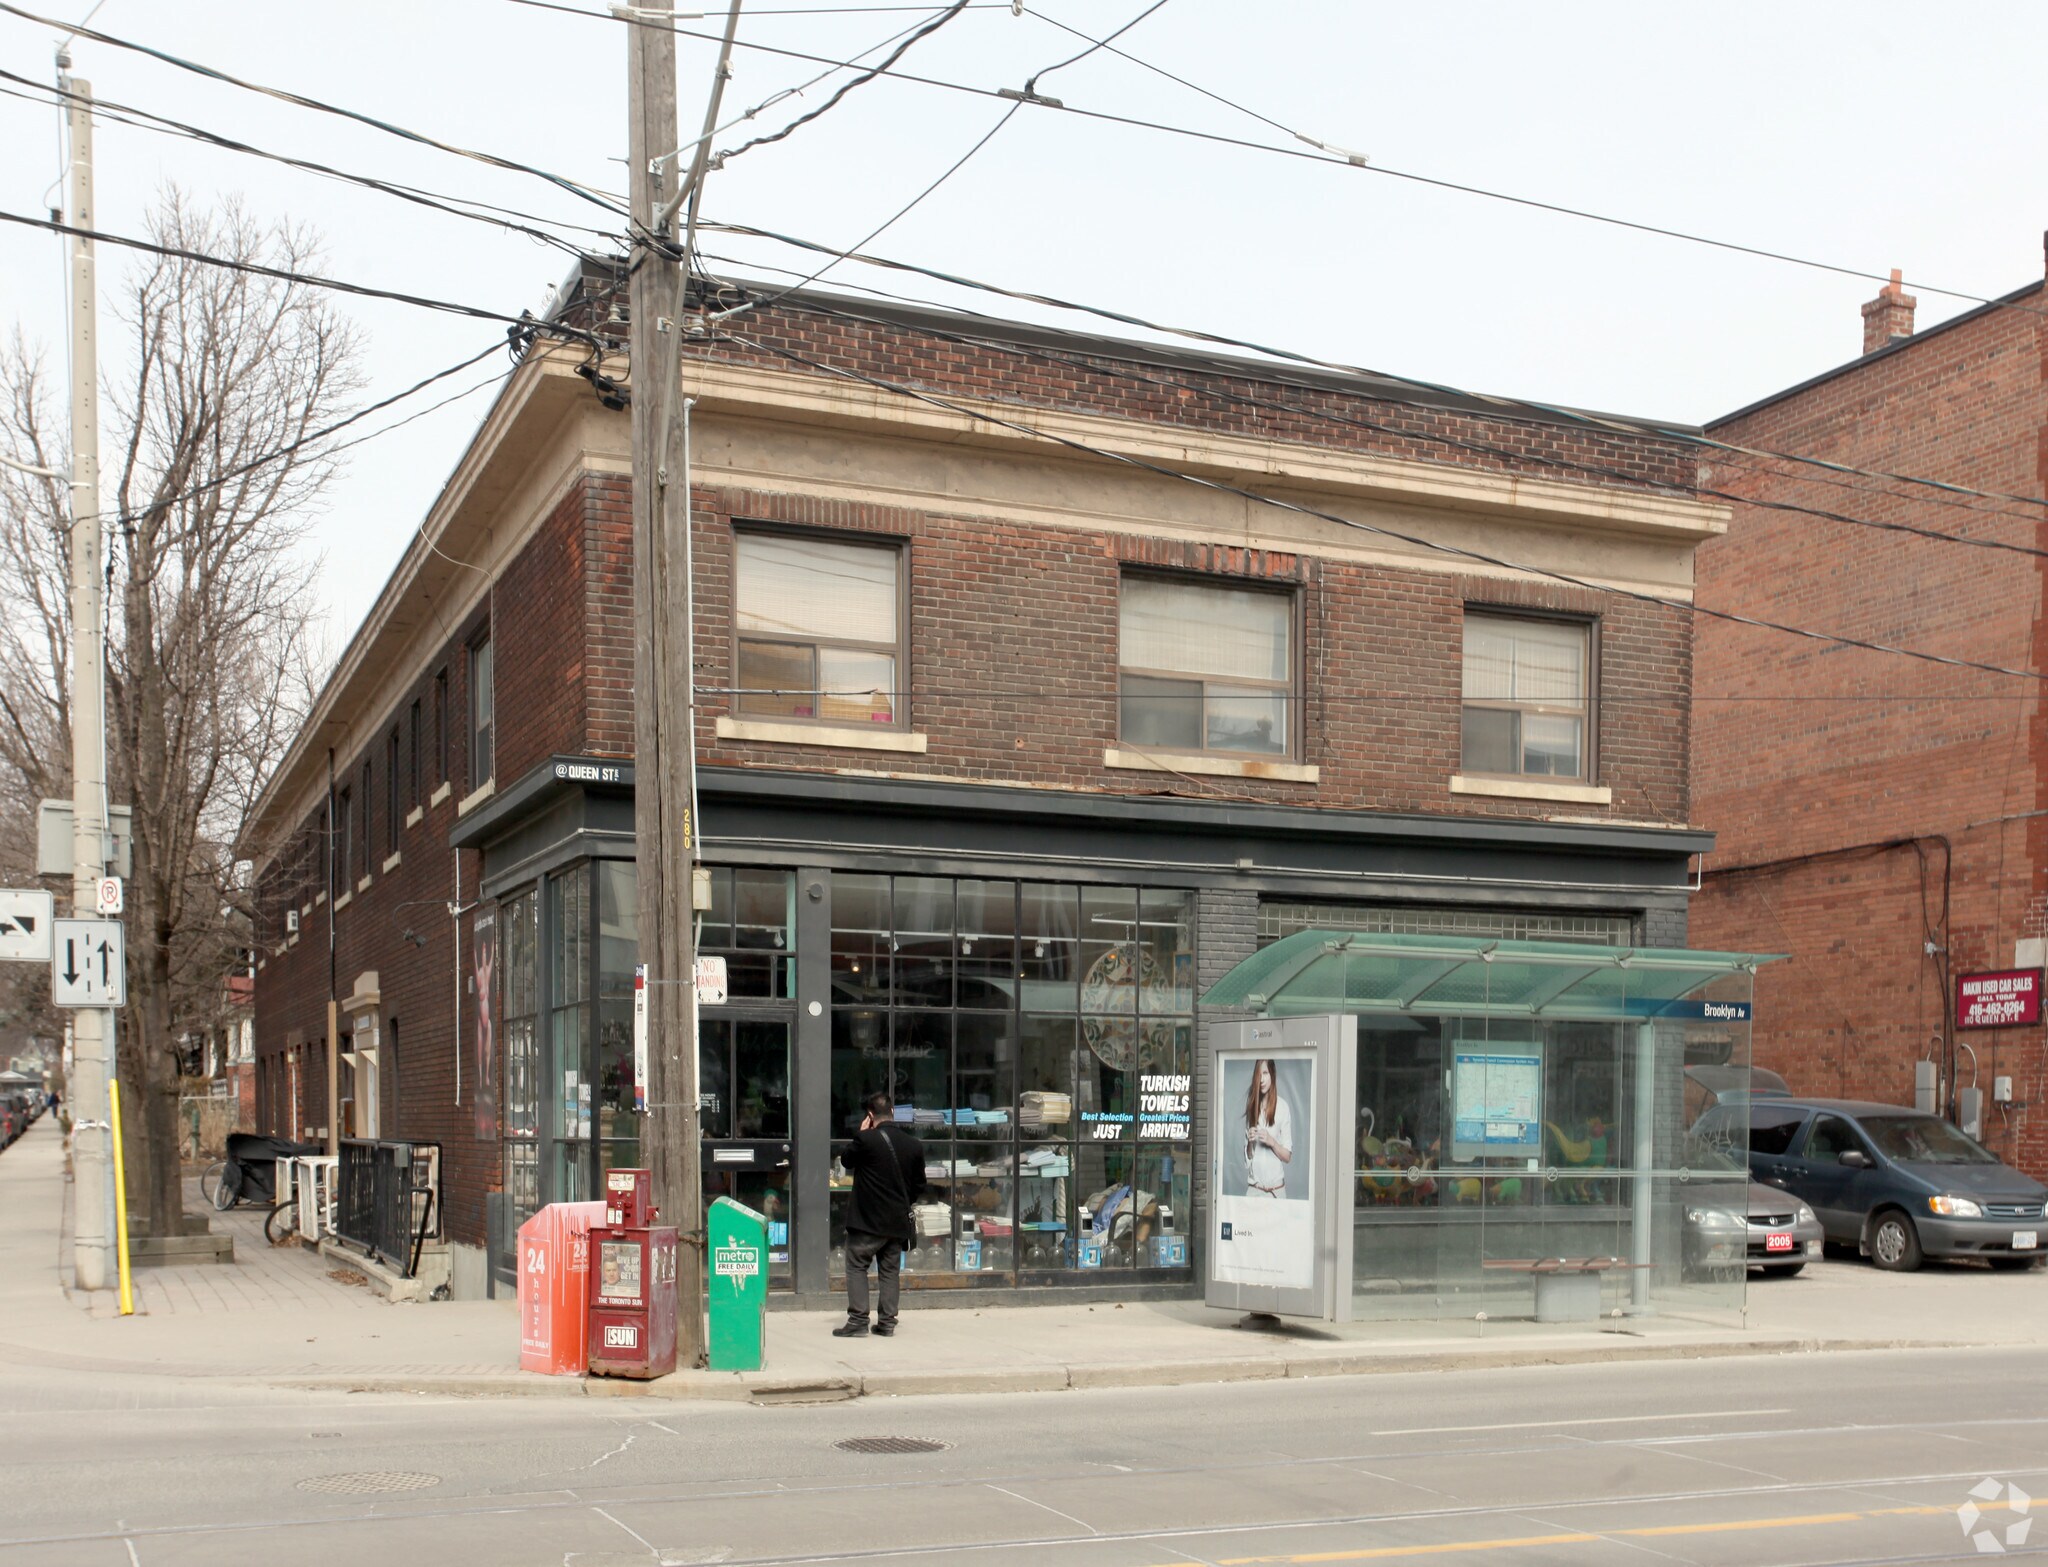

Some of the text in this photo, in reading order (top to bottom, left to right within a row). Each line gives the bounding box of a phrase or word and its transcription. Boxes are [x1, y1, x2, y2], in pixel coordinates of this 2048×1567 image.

[568, 765, 600, 780] QUEEN
[703, 960, 716, 973] NO
[697, 975, 725, 988] TANDING
[1982, 980, 1998, 994] USED
[1999, 979, 2012, 992] CAR
[2013, 977, 2032, 991] SALES
[1704, 1003, 1745, 1020] Brooklyn Av
[1969, 1001, 2025, 1016] 416-462-0264
[1974, 1014, 1999, 1024] QUEEN
[1140, 1075, 1191, 1092] TURKISH
[1140, 1094, 1190, 1112] TOWELS
[1081, 1111, 1190, 1122] Best Selection Greatest Prices
[1093, 1124, 1123, 1139] JUST
[1768, 1236, 1791, 1247] 2005
[573, 1242, 588, 1258] 24
[719, 1250, 755, 1262] metro
[527, 1248, 546, 1275] 24
[608, 1297, 631, 1305] TORONTO
[610, 1328, 635, 1346] SUN
